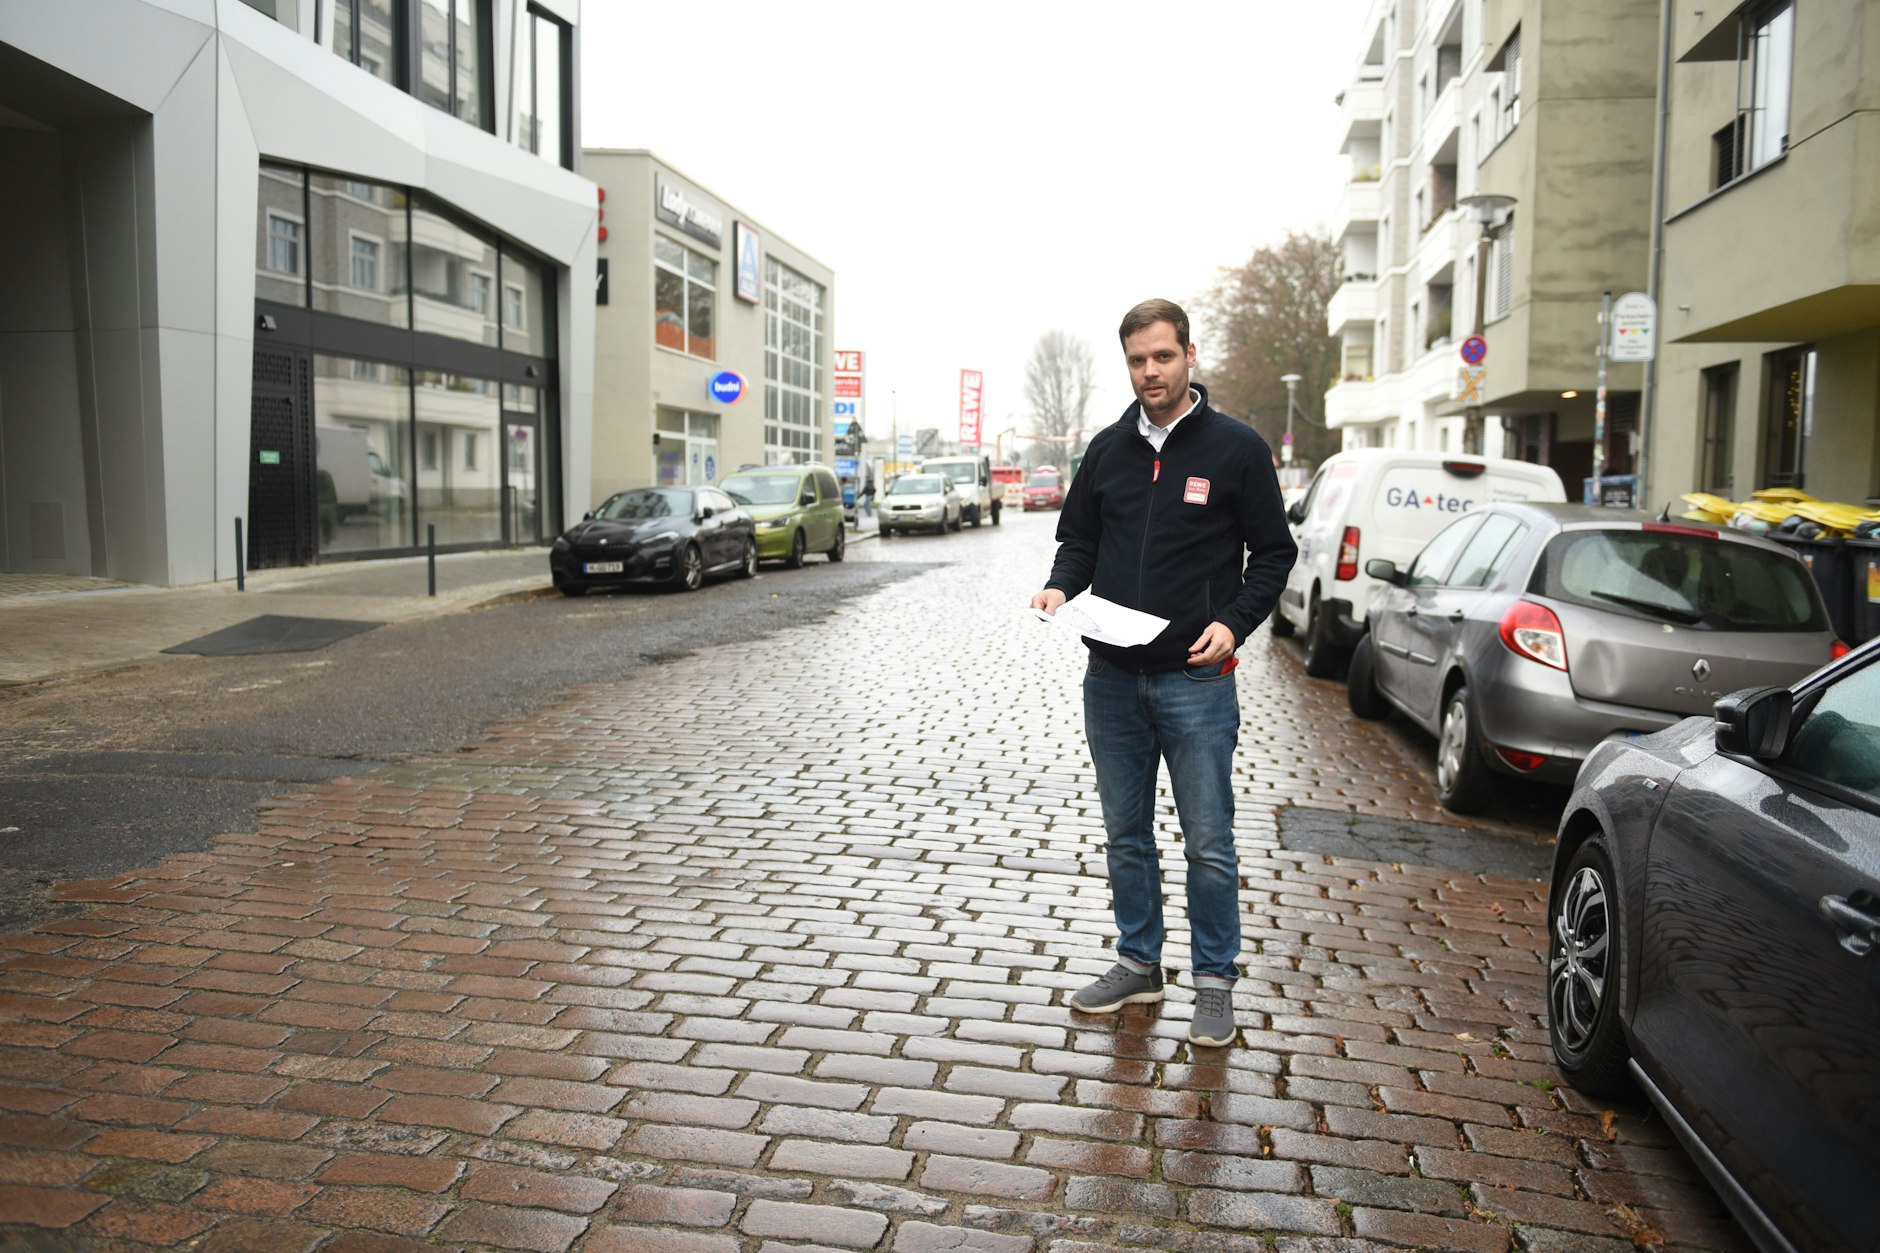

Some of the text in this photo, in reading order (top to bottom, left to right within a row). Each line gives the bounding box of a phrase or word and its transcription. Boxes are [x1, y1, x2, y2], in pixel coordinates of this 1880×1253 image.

[713, 381, 740, 393] budni
[961, 371, 982, 442] REWE
[1189, 481, 1207, 489] REWE
